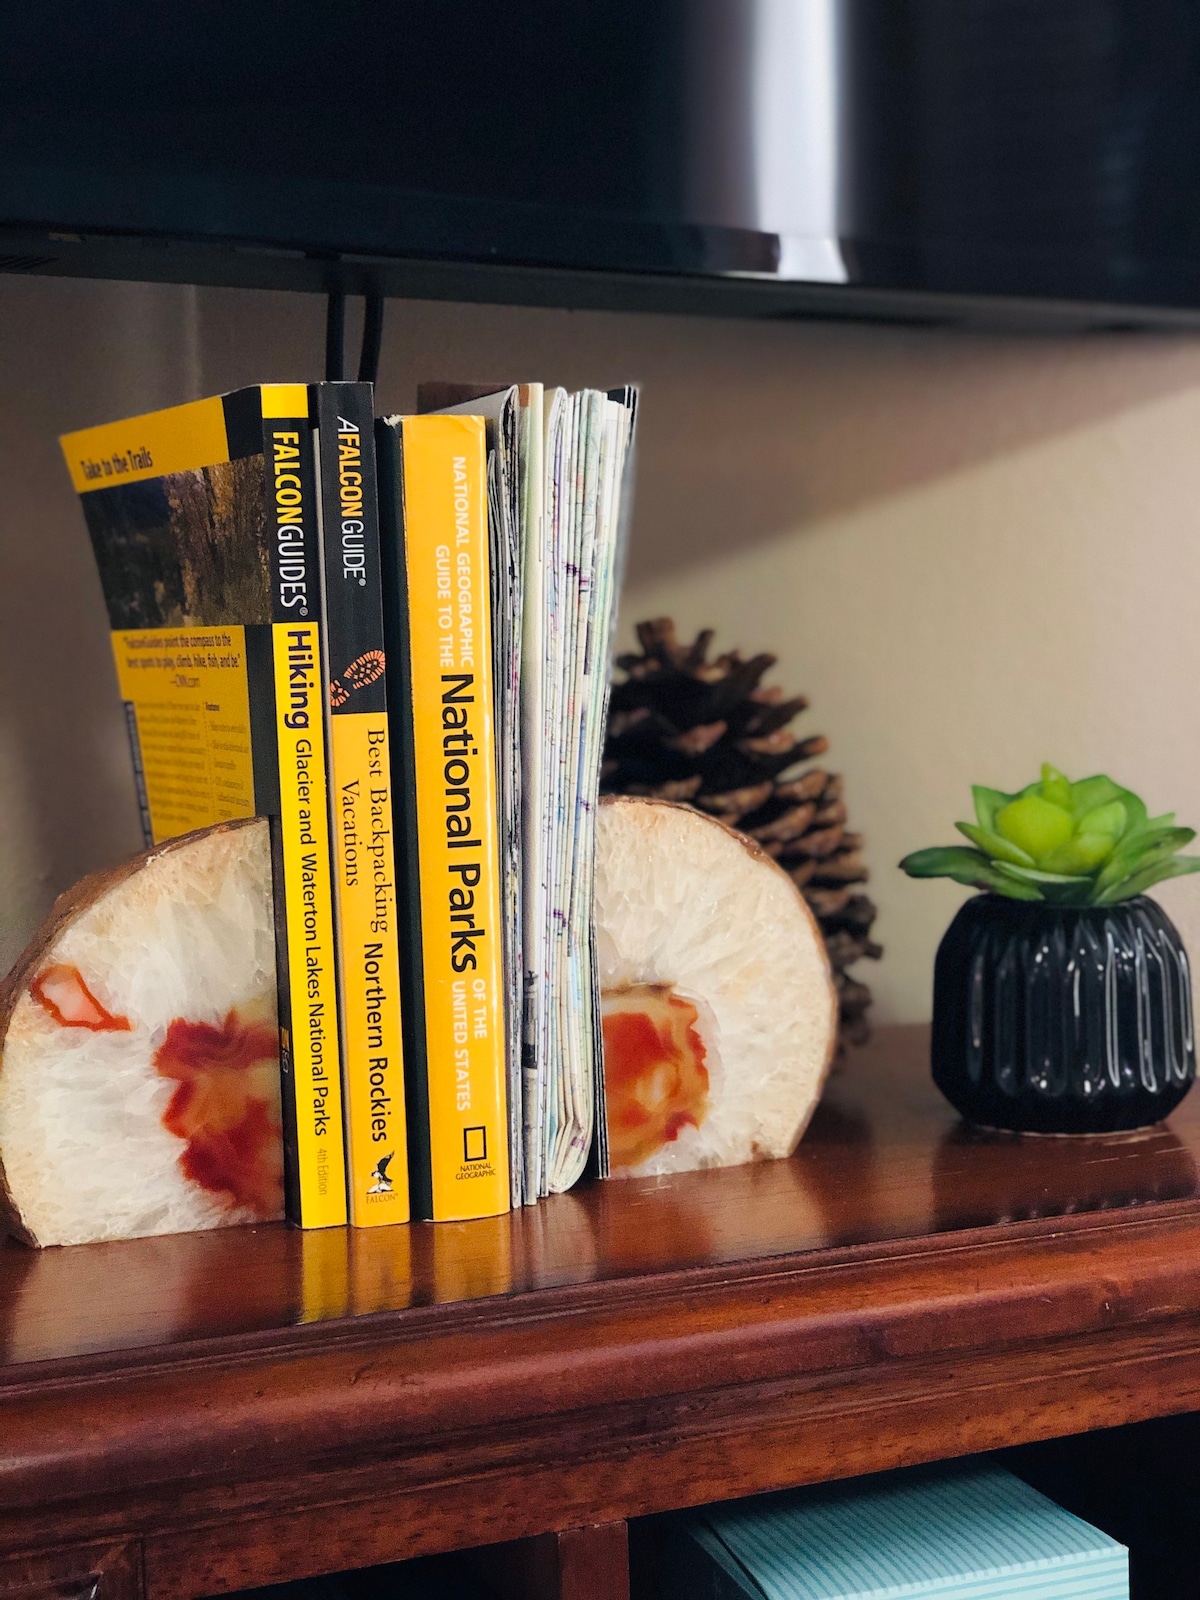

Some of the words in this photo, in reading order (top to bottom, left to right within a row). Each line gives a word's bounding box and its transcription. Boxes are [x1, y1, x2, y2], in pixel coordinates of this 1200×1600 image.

[112, 452, 129, 474] the
[126, 446, 153, 471] Trails
[453, 456, 470, 548] NATIONAL
[435, 544, 451, 599] GUIDE
[438, 604, 453, 629] TO
[457, 553, 474, 668] GEOGRAPHIC
[180, 633, 190, 648] the
[190, 634, 215, 650] compass
[214, 634, 222, 647] to
[221, 632, 232, 647] the
[193, 652, 208, 669] hike,
[207, 652, 220, 669] fish,
[220, 652, 231, 668] and
[439, 632, 454, 667] THE
[284, 630, 314, 730] Hiking
[295, 739, 314, 805] Glacier
[367, 728, 386, 777] Best
[441, 673, 482, 849] National
[298, 810, 317, 845] and
[341, 778, 363, 886] Vacations
[366, 786, 393, 933] Backpacking
[301, 852, 319, 941] Waterton
[448, 863, 486, 973] Parks
[305, 946, 323, 999] Lakes
[363, 942, 387, 1049] Northern
[472, 978, 487, 1000] OF
[451, 980, 468, 1045] UNITED
[474, 1004, 488, 1039] THE
[308, 1003, 328, 1081] National
[369, 1056, 391, 1142] Rockies
[454, 1048, 471, 1112] STATES
[313, 1086, 331, 1137] Parks
[317, 1164, 329, 1196] Edition
[455, 1168, 496, 1181] GEOGRAPHIC
[459, 1162, 493, 1173] NATIONAL
